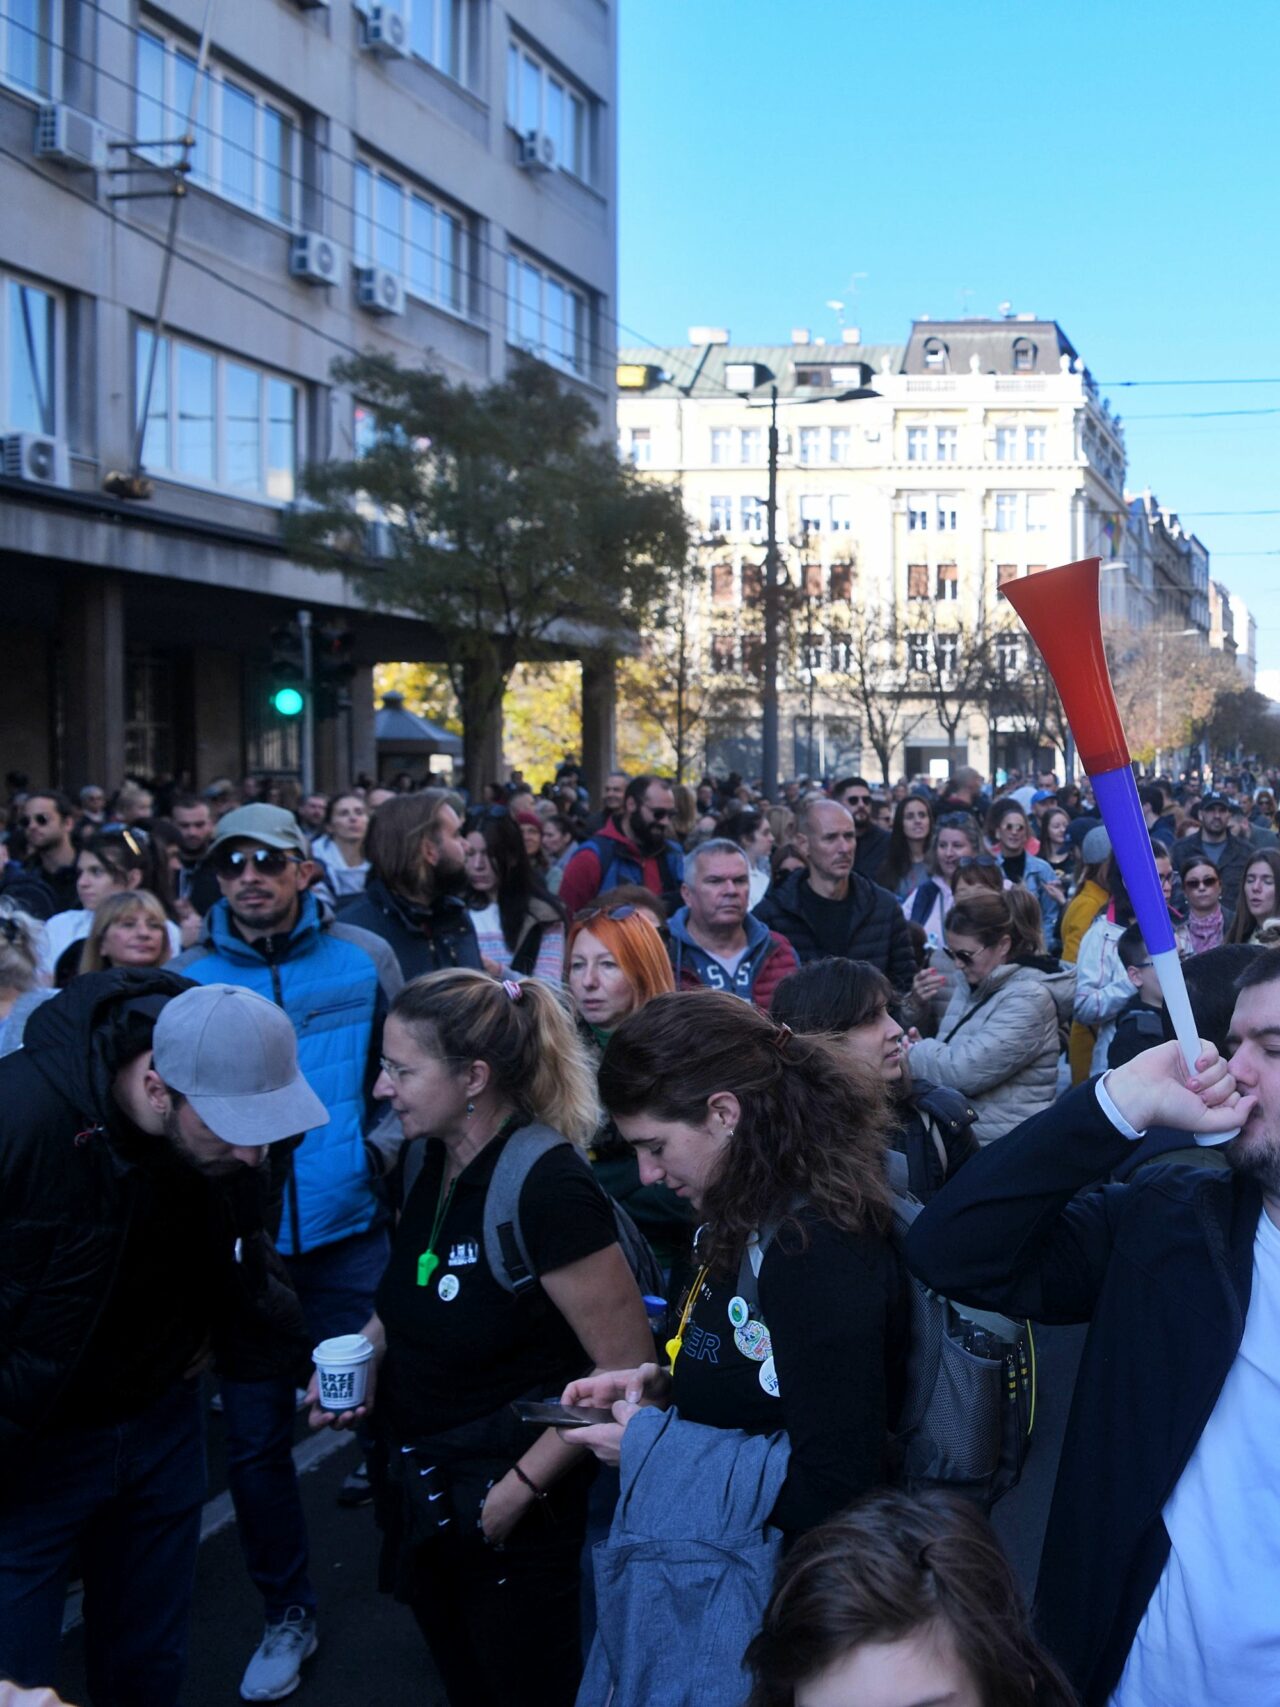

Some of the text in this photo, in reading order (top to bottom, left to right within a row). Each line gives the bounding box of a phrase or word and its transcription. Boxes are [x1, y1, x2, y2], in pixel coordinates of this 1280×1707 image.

[683, 1324, 721, 1364] ER
[321, 1372, 355, 1383] BRZE
[321, 1382, 354, 1391] KAFE
